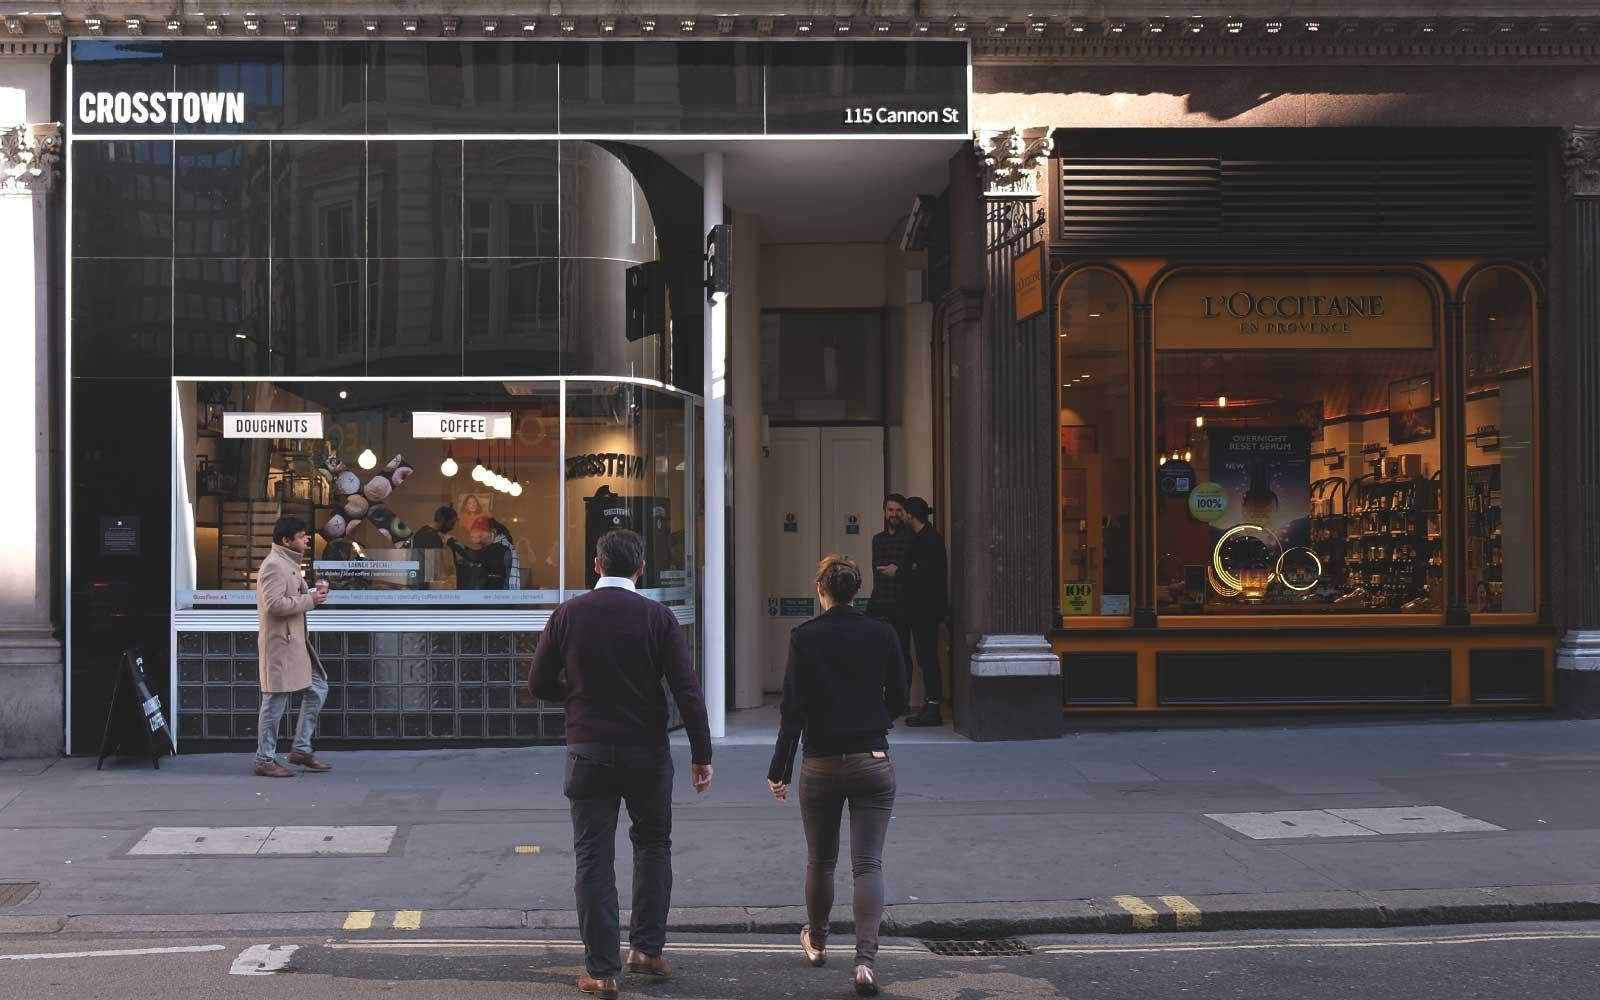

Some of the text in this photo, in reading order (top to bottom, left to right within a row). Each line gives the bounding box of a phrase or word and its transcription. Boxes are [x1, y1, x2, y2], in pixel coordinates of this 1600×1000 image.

[79, 91, 246, 125] CROSSTOWN
[844, 107, 959, 123] 115 Cannon St
[1201, 290, 1385, 320] L'OCCITANE
[1239, 322, 1353, 334] EN PROVENCE
[235, 418, 308, 434] DOUGHNUTS
[440, 418, 485, 433] COFFEE
[1232, 434, 1288, 443] OVERNIGHT
[1229, 442, 1292, 451] RESET SERUM
[1225, 462, 1245, 470] NEW
[1197, 498, 1222, 509] 100%
